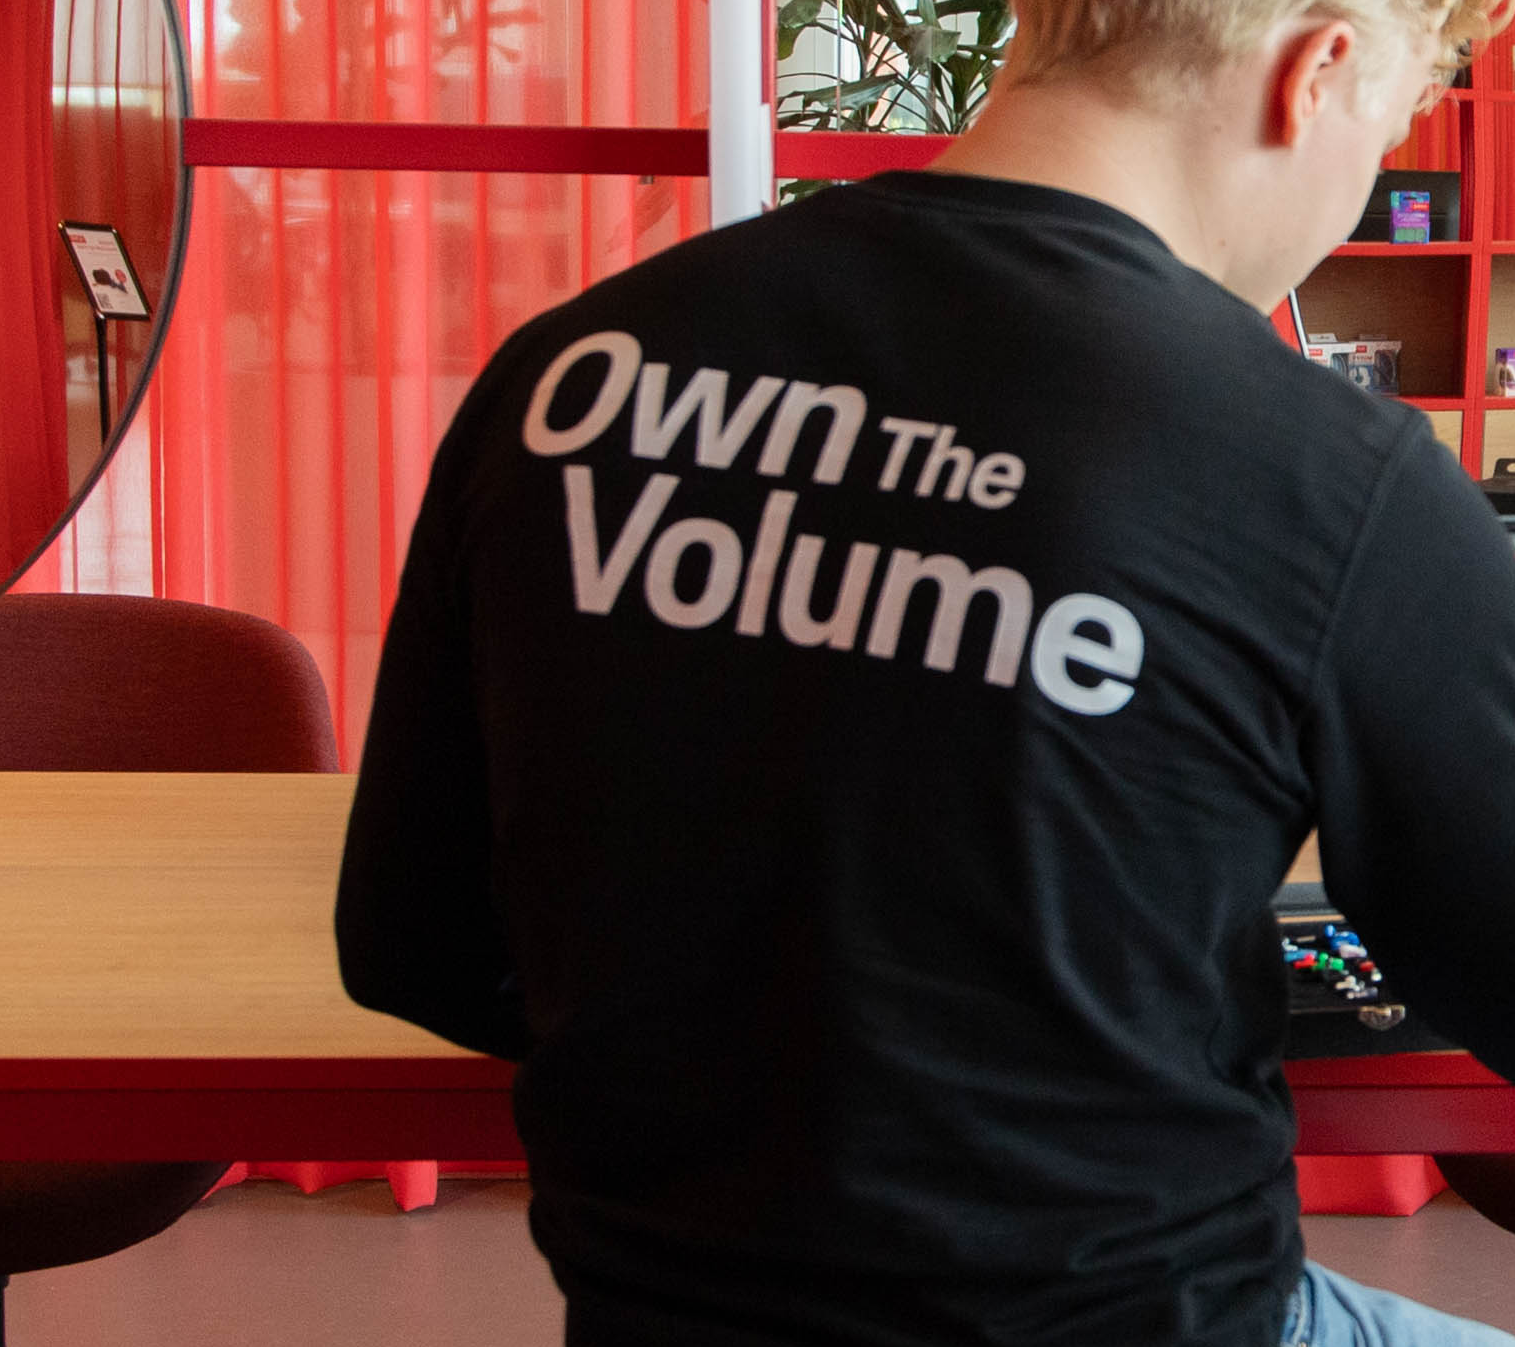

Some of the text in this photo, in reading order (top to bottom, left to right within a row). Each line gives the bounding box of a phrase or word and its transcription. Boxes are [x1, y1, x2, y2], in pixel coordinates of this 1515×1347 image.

[521, 329, 1027, 510] Own The
[562, 464, 1146, 717] Volume
